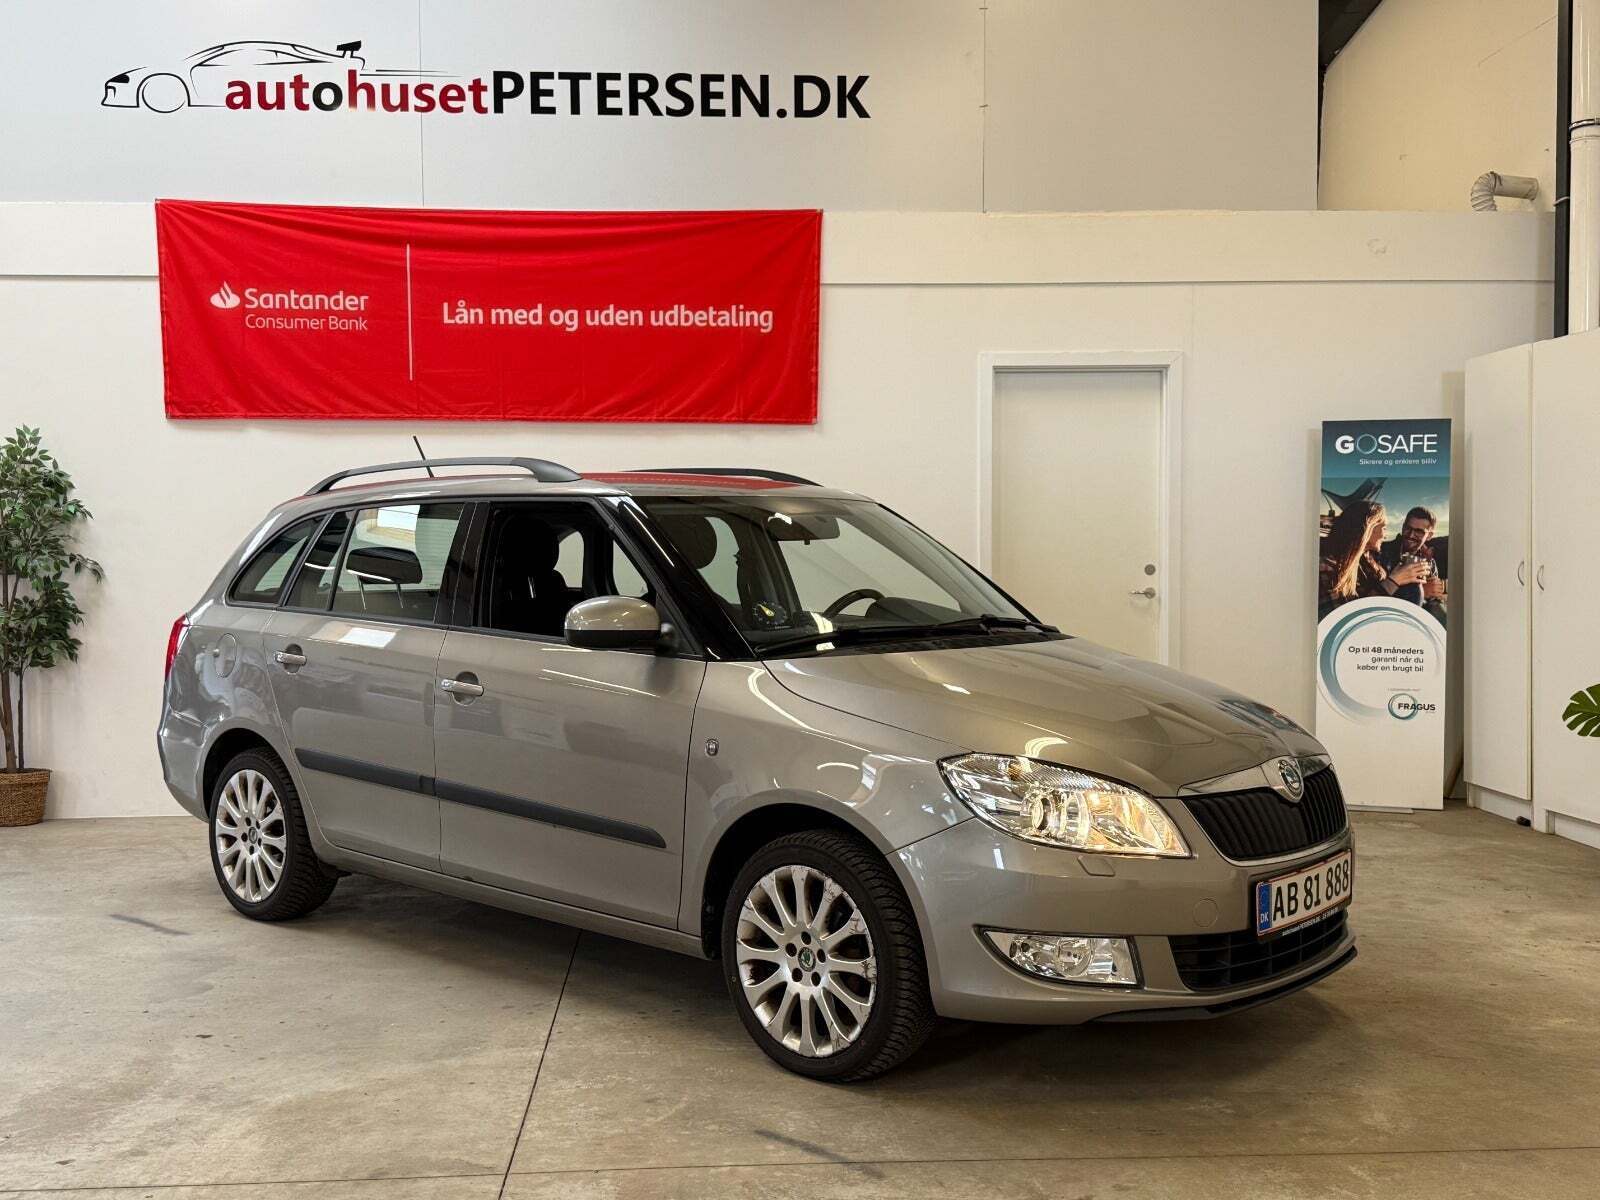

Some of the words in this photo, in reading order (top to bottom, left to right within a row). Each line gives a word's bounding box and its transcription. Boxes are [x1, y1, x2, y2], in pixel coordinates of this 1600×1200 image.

[244, 287, 369, 311] Santander
[245, 313, 326, 330] Consumer
[328, 315, 368, 331] Bank
[442, 300, 484, 325] Lån
[490, 303, 543, 326] med
[549, 307, 579, 332] og
[585, 303, 643, 326] uden
[650, 304, 774, 333] udbetaling
[1335, 434, 1438, 454] GOSAFE
[1348, 646, 1360, 655] Op
[1371, 646, 1382, 654] 48
[1384, 646, 1424, 655] måneders
[1371, 656, 1398, 664] garanti
[1392, 664, 1412, 673] brugt
[1398, 703, 1436, 711] FRAGUS
[1273, 881, 1299, 921] AB
[1303, 872, 1321, 911] 81
[1325, 859, 1349, 900] 888
[1260, 912, 1269, 923] DK
